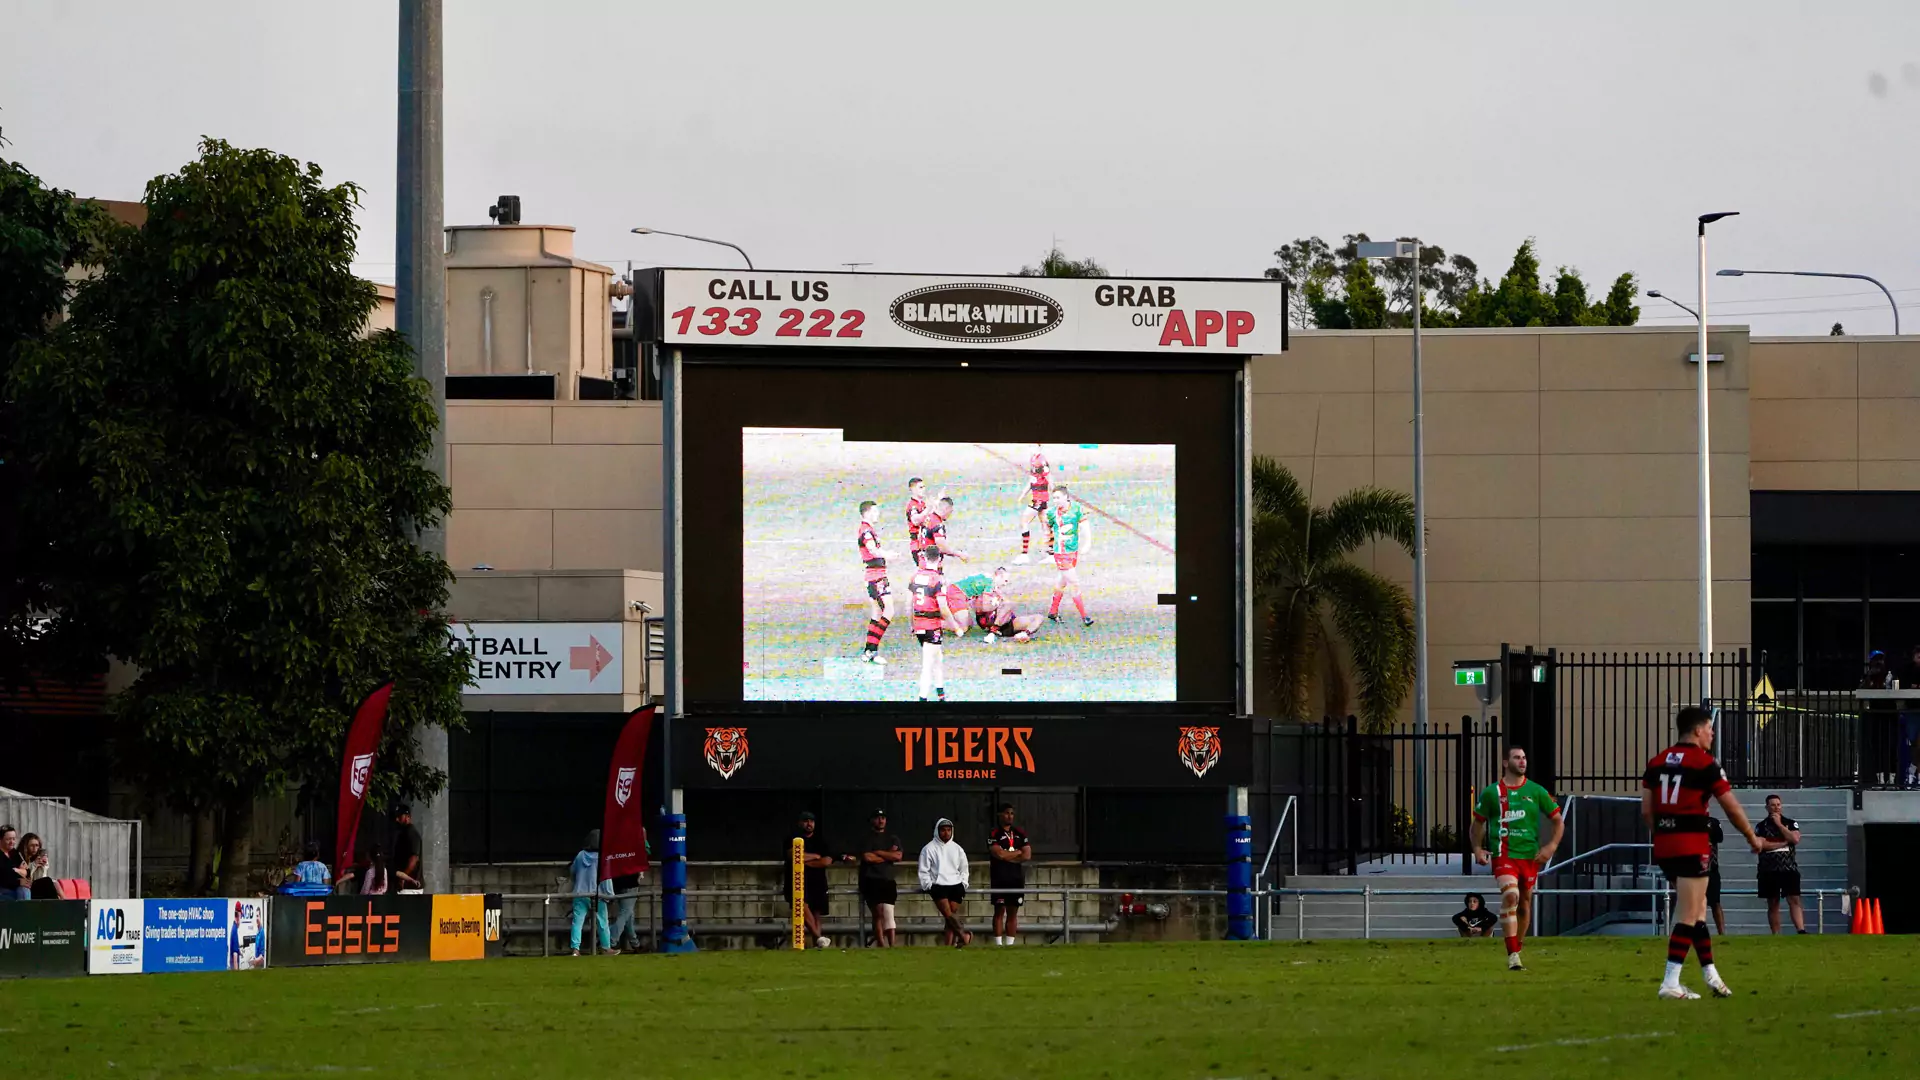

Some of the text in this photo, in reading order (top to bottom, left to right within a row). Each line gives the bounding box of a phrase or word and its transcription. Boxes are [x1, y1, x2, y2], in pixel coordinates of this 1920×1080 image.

[708, 279, 829, 302] CALL US
[1095, 284, 1176, 308] GRAB
[671, 306, 866, 338] 133 222
[903, 302, 1048, 324] BLACK&WHITE
[965, 324, 992, 334] CABS
[1132, 309, 1255, 348] our APP
[916, 587, 925, 605] 3
[478, 661, 562, 679] ENTRY
[894, 727, 1036, 774] TIGERS
[937, 769, 997, 779] BRISBANE
[1659, 773, 1682, 804] 17
[1504, 809, 1526, 819] BMD
[97, 907, 125, 941] ACD
[126, 930, 140, 941] TRADE
[158, 907, 215, 923] The one-stop HVAC shop
[485, 909, 501, 942] CAT
[145, 925, 226, 941] Giving tradies the power to compete
[305, 901, 400, 955] Easts
[439, 918, 480, 938] Hastings Deering
